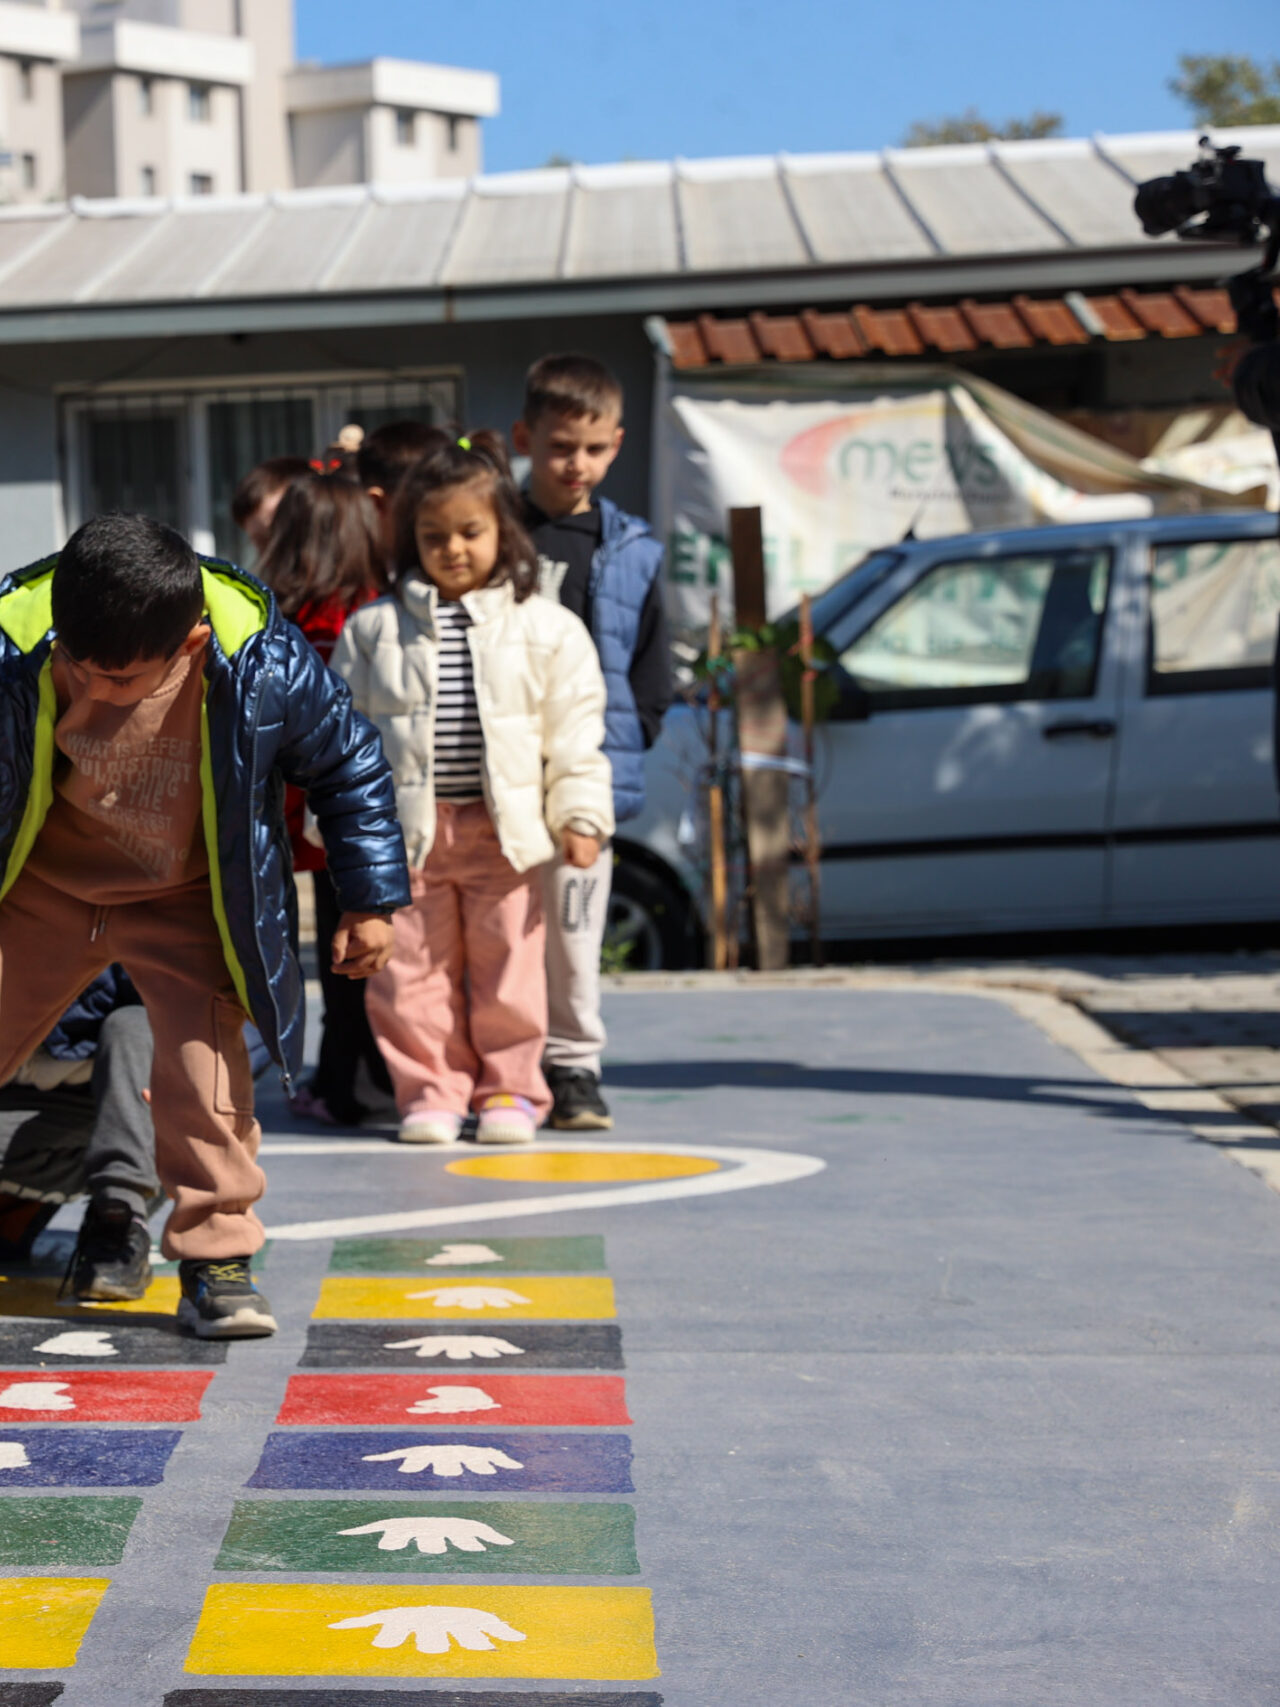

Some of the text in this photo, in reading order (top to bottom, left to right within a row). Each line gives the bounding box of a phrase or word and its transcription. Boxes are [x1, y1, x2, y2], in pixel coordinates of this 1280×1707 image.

[66, 733, 192, 760] WHAT IS DEFEAT
